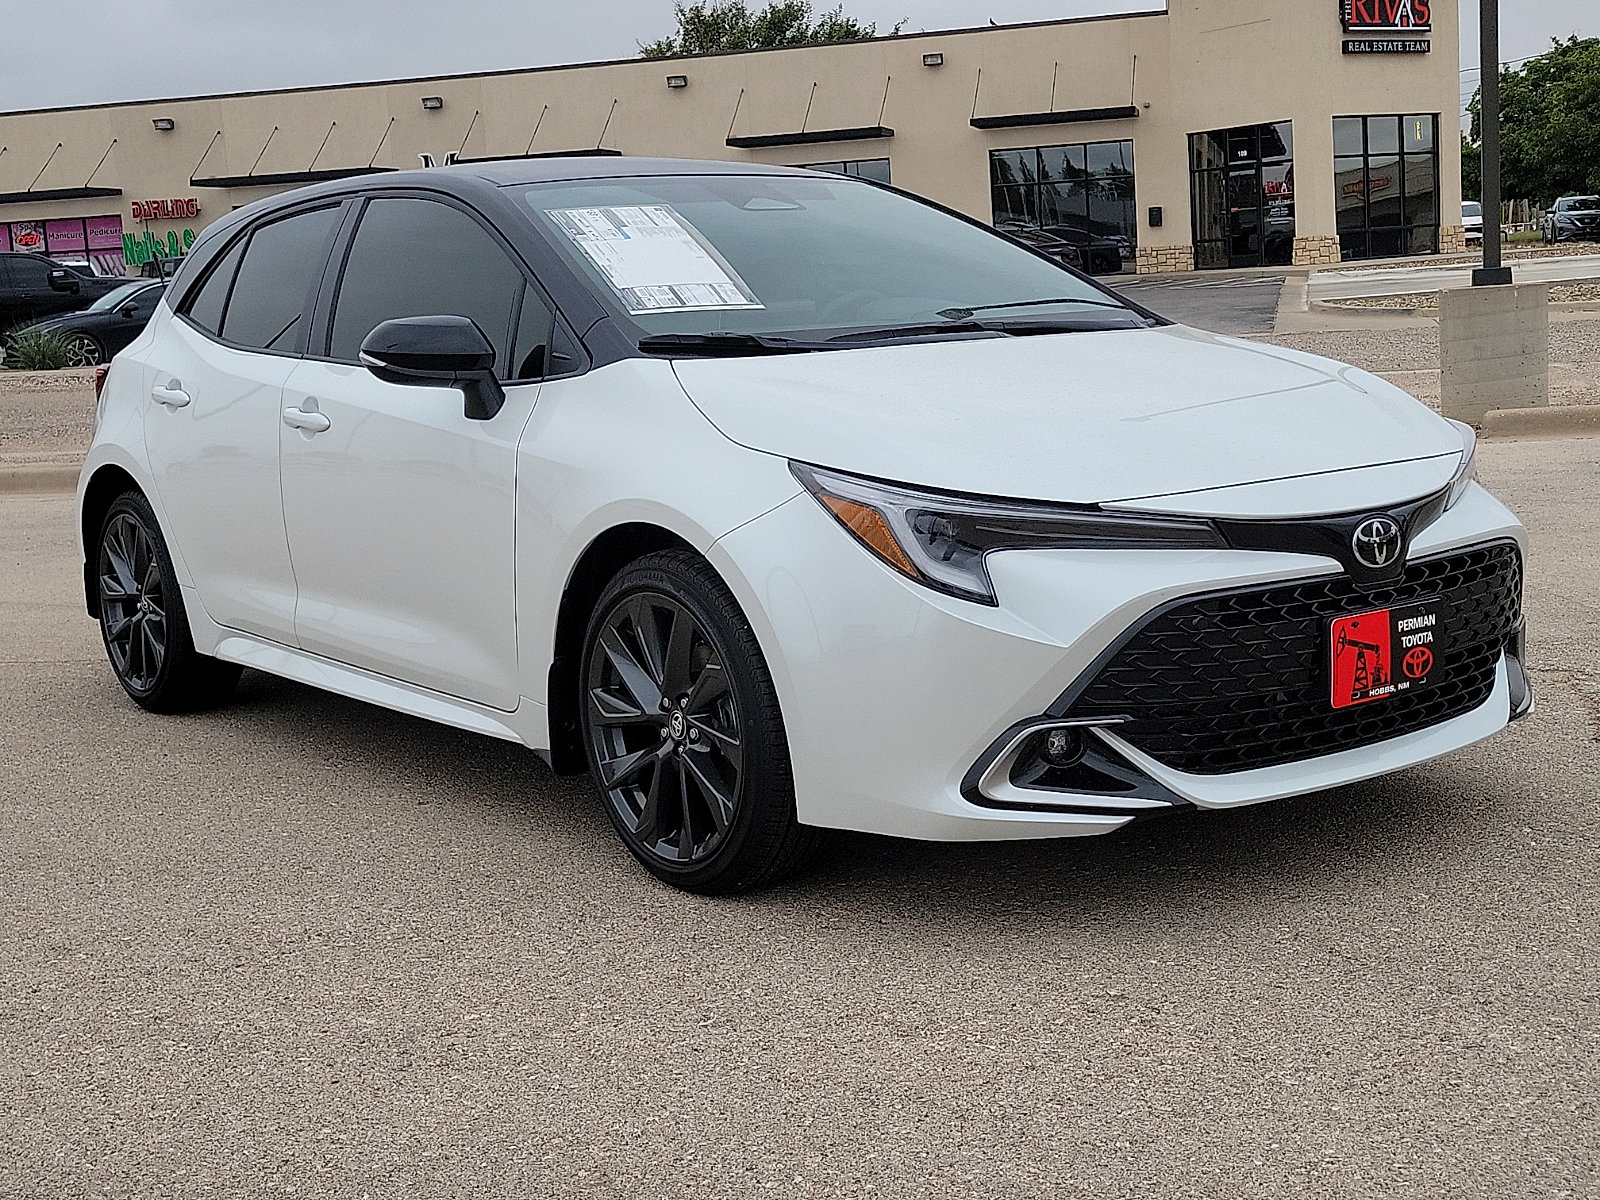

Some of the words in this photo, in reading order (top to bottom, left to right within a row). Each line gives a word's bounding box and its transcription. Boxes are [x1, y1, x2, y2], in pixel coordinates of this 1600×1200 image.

[1349, 42, 1371, 51] REAL
[1373, 42, 1403, 51] ESTATE
[1405, 42, 1428, 51] TEAM
[131, 198, 197, 219] DARLING
[16, 234, 40, 245] OPEN
[48, 232, 83, 240] Manicure
[89, 227, 122, 236] Pedicure
[121, 232, 164, 266] Nails
[1398, 613, 1436, 632] PERMIAN
[1401, 631, 1433, 648] TOYOTA
[1369, 684, 1396, 697] HOBBS,
[1398, 681, 1410, 691] NM
